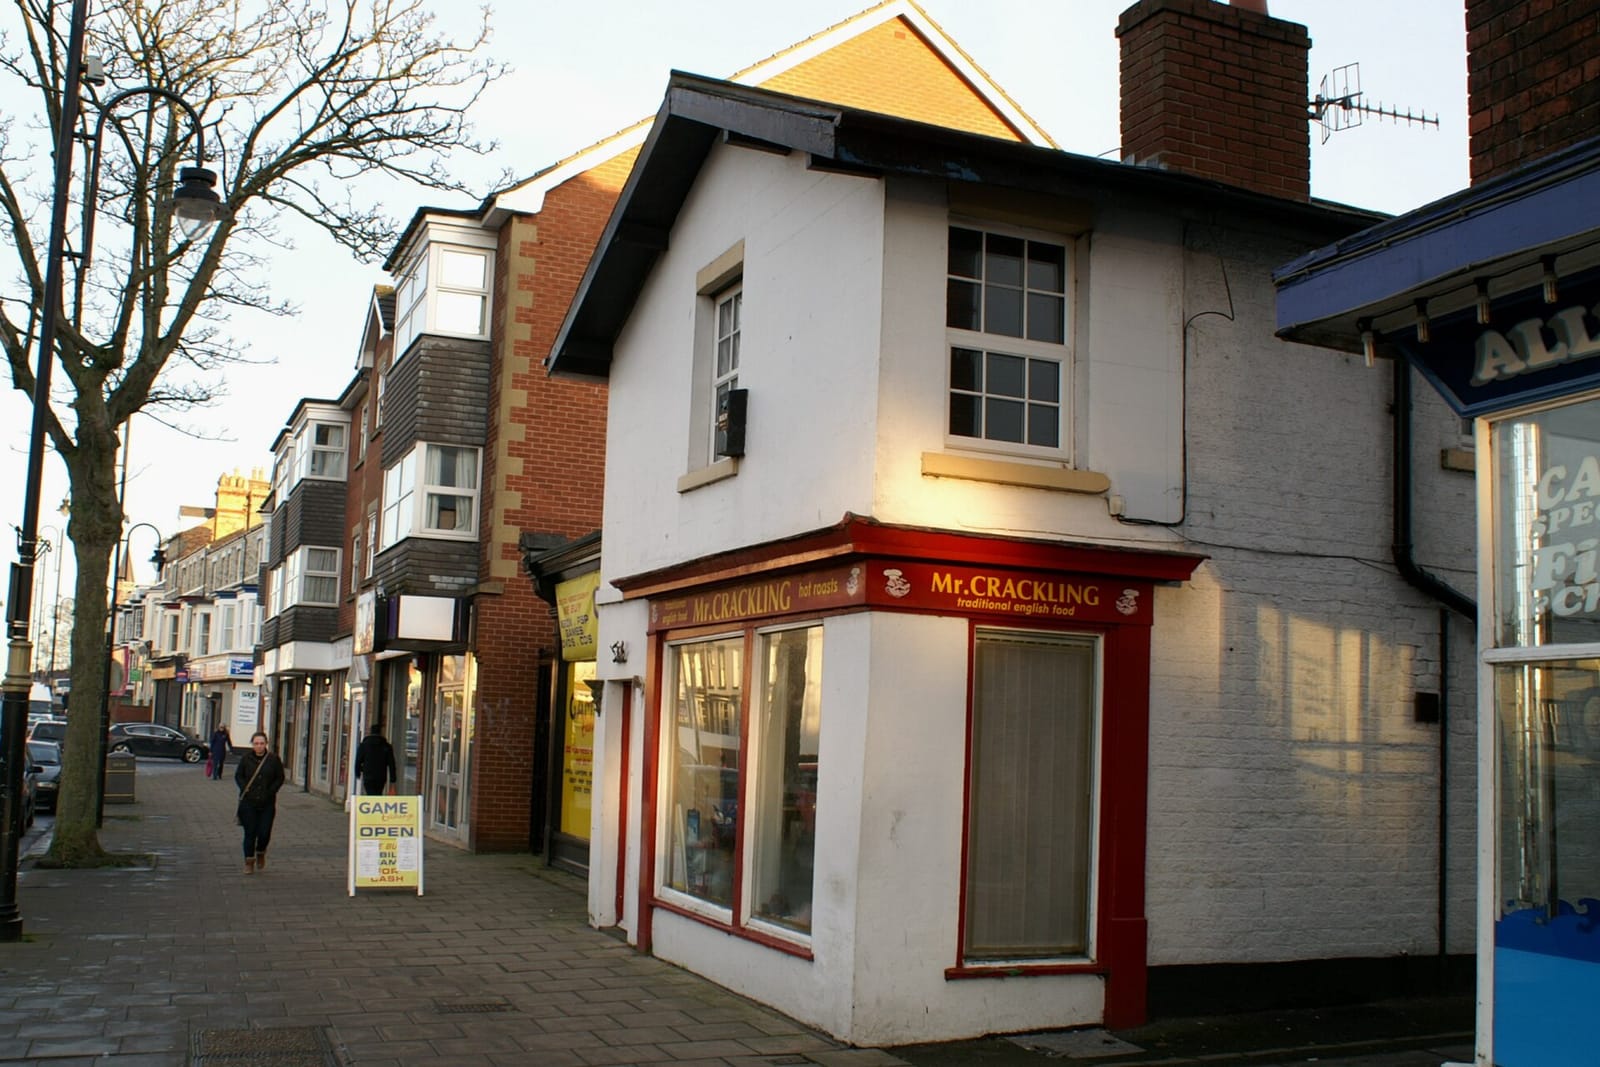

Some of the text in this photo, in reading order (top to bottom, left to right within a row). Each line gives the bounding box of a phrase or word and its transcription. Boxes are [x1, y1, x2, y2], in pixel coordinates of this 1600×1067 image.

[1470, 303, 1600, 387] ALL
[692, 578, 838, 623] Mr.CRACKLING hot roasts
[931, 572, 1099, 606] Mr.CRACKLING
[957, 597, 1075, 617] traditional english food
[359, 802, 408, 814] GAME
[360, 826, 414, 837] OPEN
